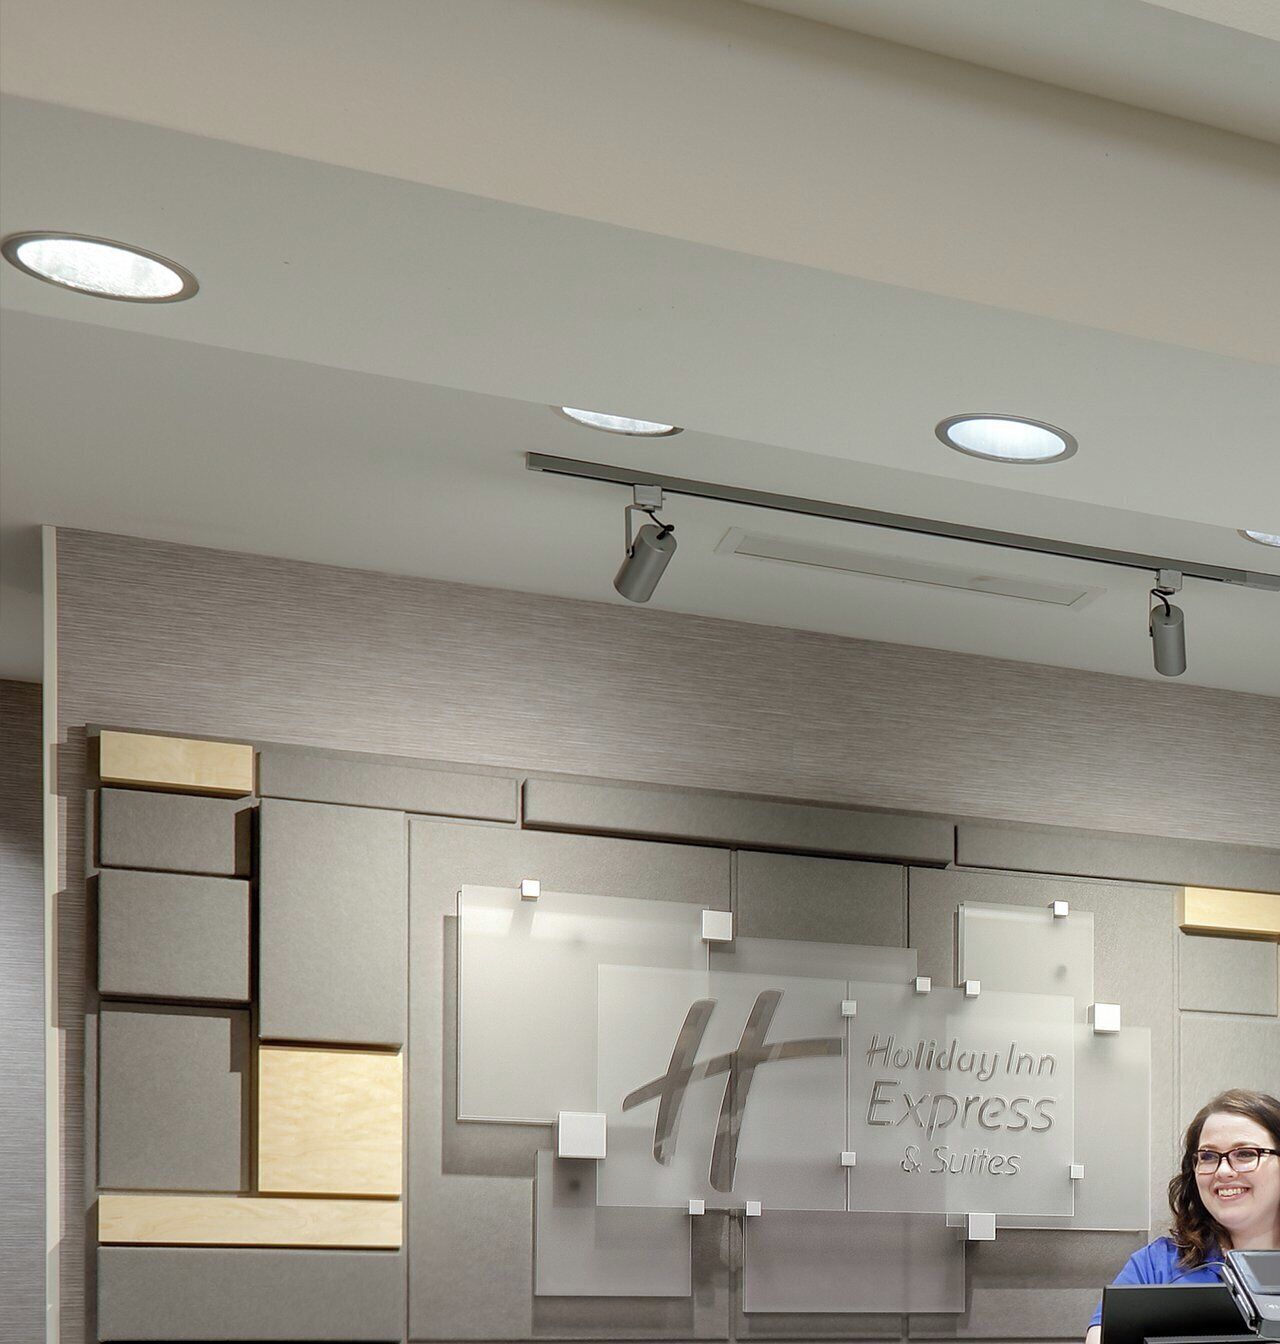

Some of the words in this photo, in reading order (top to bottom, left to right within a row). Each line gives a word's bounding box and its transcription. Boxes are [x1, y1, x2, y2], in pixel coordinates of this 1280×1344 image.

[866, 1032, 999, 1082] Holiday
[1005, 1039, 1057, 1077] Inn
[866, 1079, 1058, 1141] Express
[901, 1144, 922, 1175] &
[930, 1145, 1022, 1176] Suites
